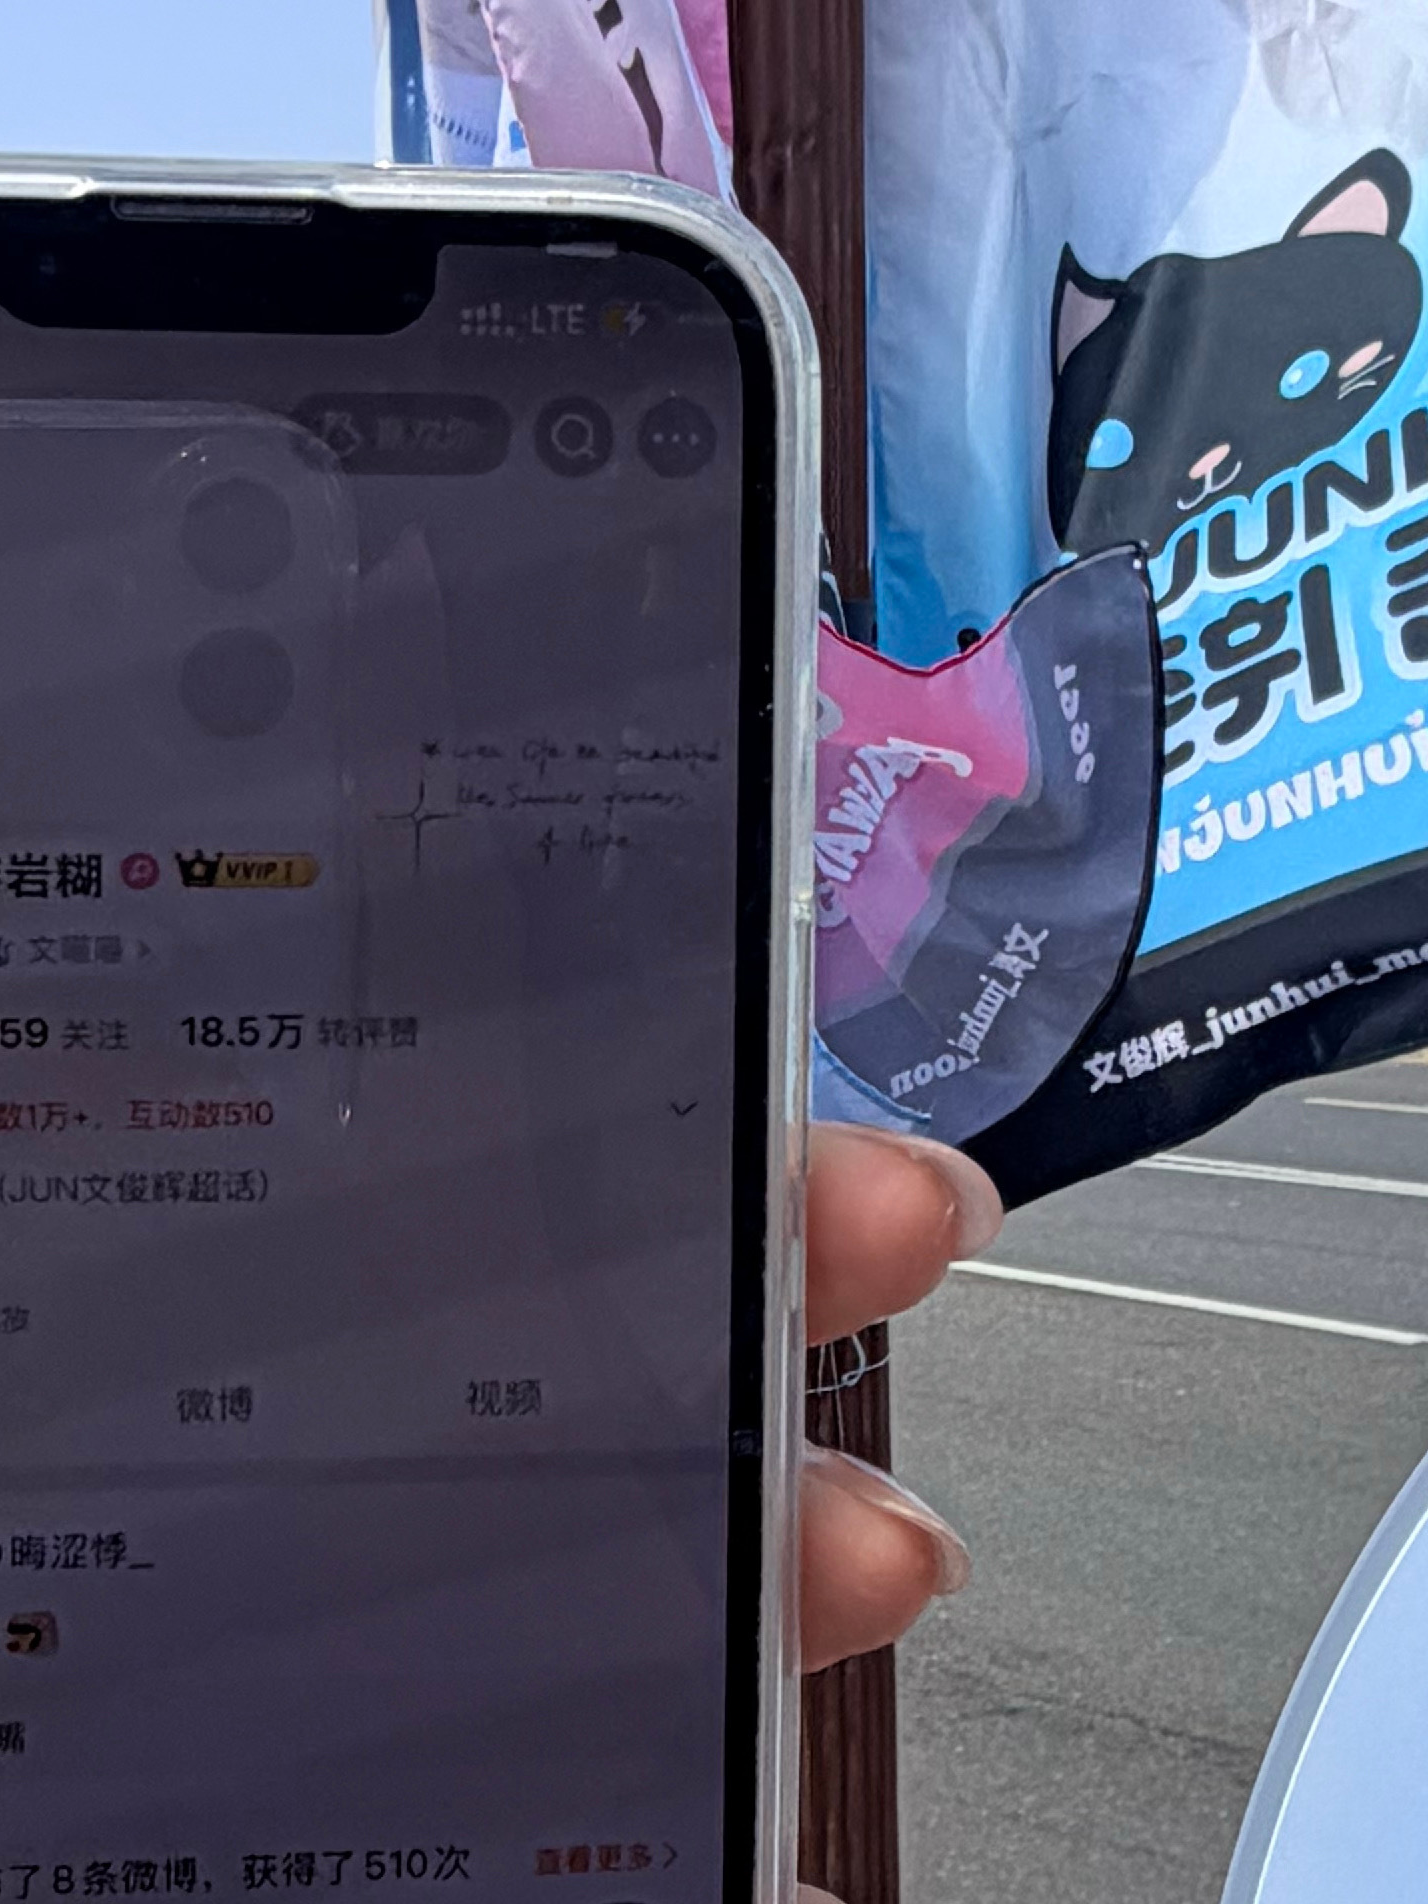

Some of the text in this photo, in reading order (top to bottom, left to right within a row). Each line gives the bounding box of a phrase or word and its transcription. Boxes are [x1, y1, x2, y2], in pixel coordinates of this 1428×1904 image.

[531, 304, 586, 335] LTE
[60, 1020, 130, 1052] 关注
[180, 1012, 304, 1051] 18.5万
[176, 1385, 253, 1425] 微博
[464, 1376, 544, 1418] 视频
